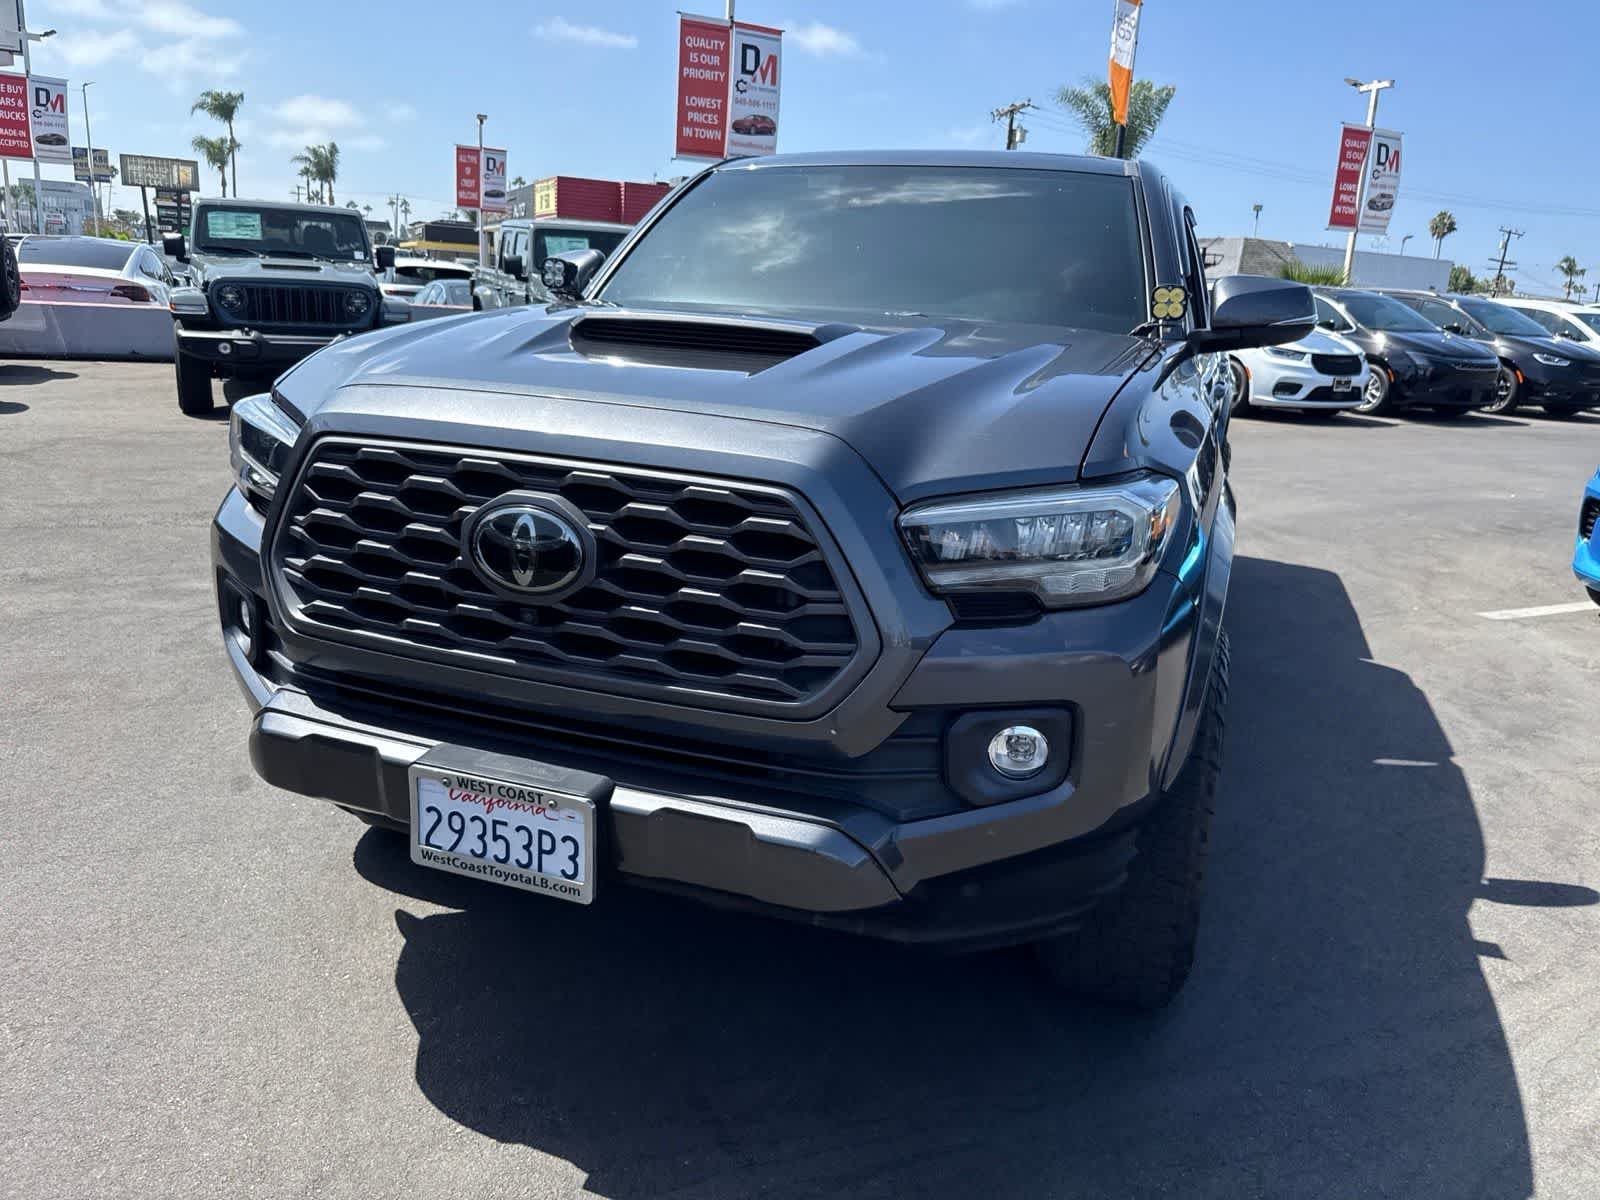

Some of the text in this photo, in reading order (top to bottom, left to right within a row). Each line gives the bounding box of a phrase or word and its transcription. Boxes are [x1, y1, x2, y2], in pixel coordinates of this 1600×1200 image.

[685, 36, 725, 51] QUALITY
[690, 52, 720, 66] IS OUR
[683, 67, 725, 81] PRIORITY
[7, 83, 24, 95] BUY
[17, 98, 24, 108] &
[685, 96, 722, 110] LOWEST
[687, 112, 719, 125] PRICES
[682, 126, 721, 141] IN TOWN
[0, 139, 29, 148] CCEPTED
[1344, 138, 1368, 150] QUALIT
[456, 776, 544, 806] WEST COAST
[425, 806, 580, 881] 29353P3
[421, 849, 581, 897] WestCoastToyotaLB.com
